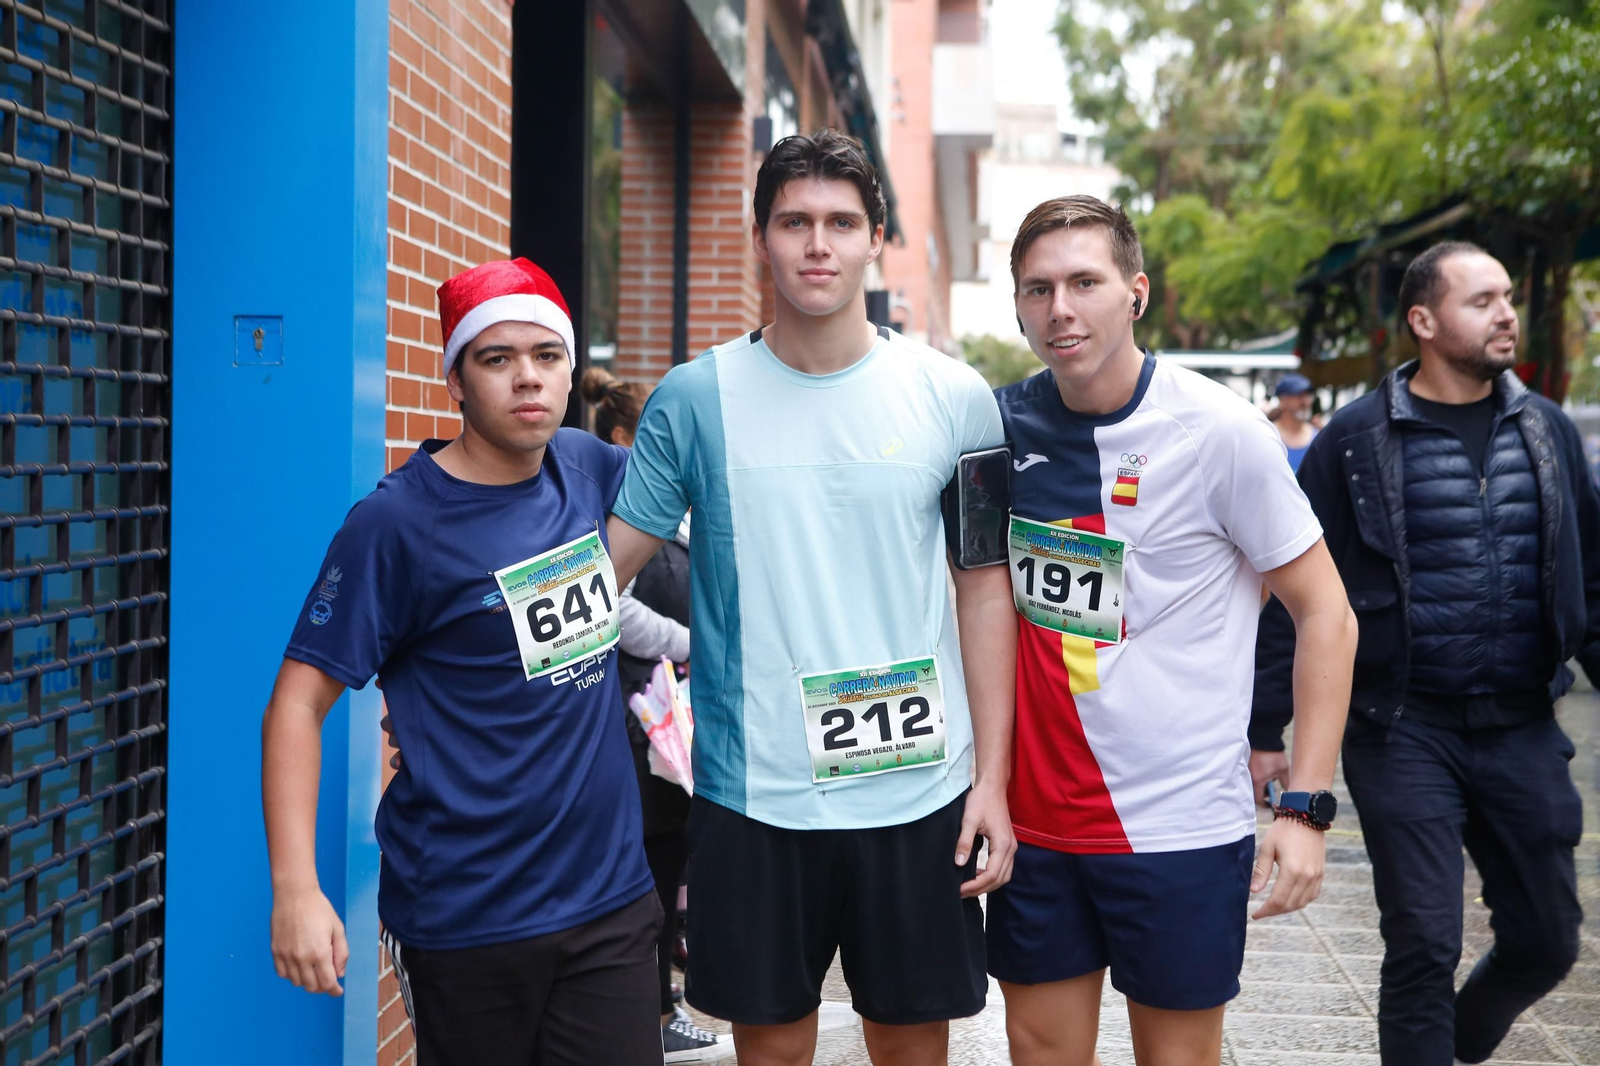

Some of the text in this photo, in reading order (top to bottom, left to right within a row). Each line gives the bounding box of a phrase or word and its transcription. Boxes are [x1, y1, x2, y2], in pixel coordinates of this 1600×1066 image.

[1026, 531, 1062, 552] CARRERA
[1063, 540, 1102, 560] NAVIDAD
[1058, 531, 1080, 540] EDICIÓN
[527, 548, 594, 589] CARRERA NAVIDAD
[1071, 556, 1101, 568] ALGECIRAS
[1017, 556, 1104, 612] 191
[526, 572, 612, 643] 641
[1036, 602, 1061, 614] FERNÁNDEZ,
[1062, 608, 1082, 618] NICOLÁS
[552, 635, 575, 650] REDONDO
[575, 626, 595, 640] ZAMORA,
[550, 646, 615, 686] CUPR
[868, 668, 892, 676] EDICIÓN
[575, 668, 606, 691] TURIA
[829, 670, 918, 698] CARRERA NAVIDAD
[888, 686, 918, 698] ALGECIRAS
[820, 696, 934, 751] 212
[845, 742, 916, 759] ESPINOSA VEGAZO, ÁLVARO
